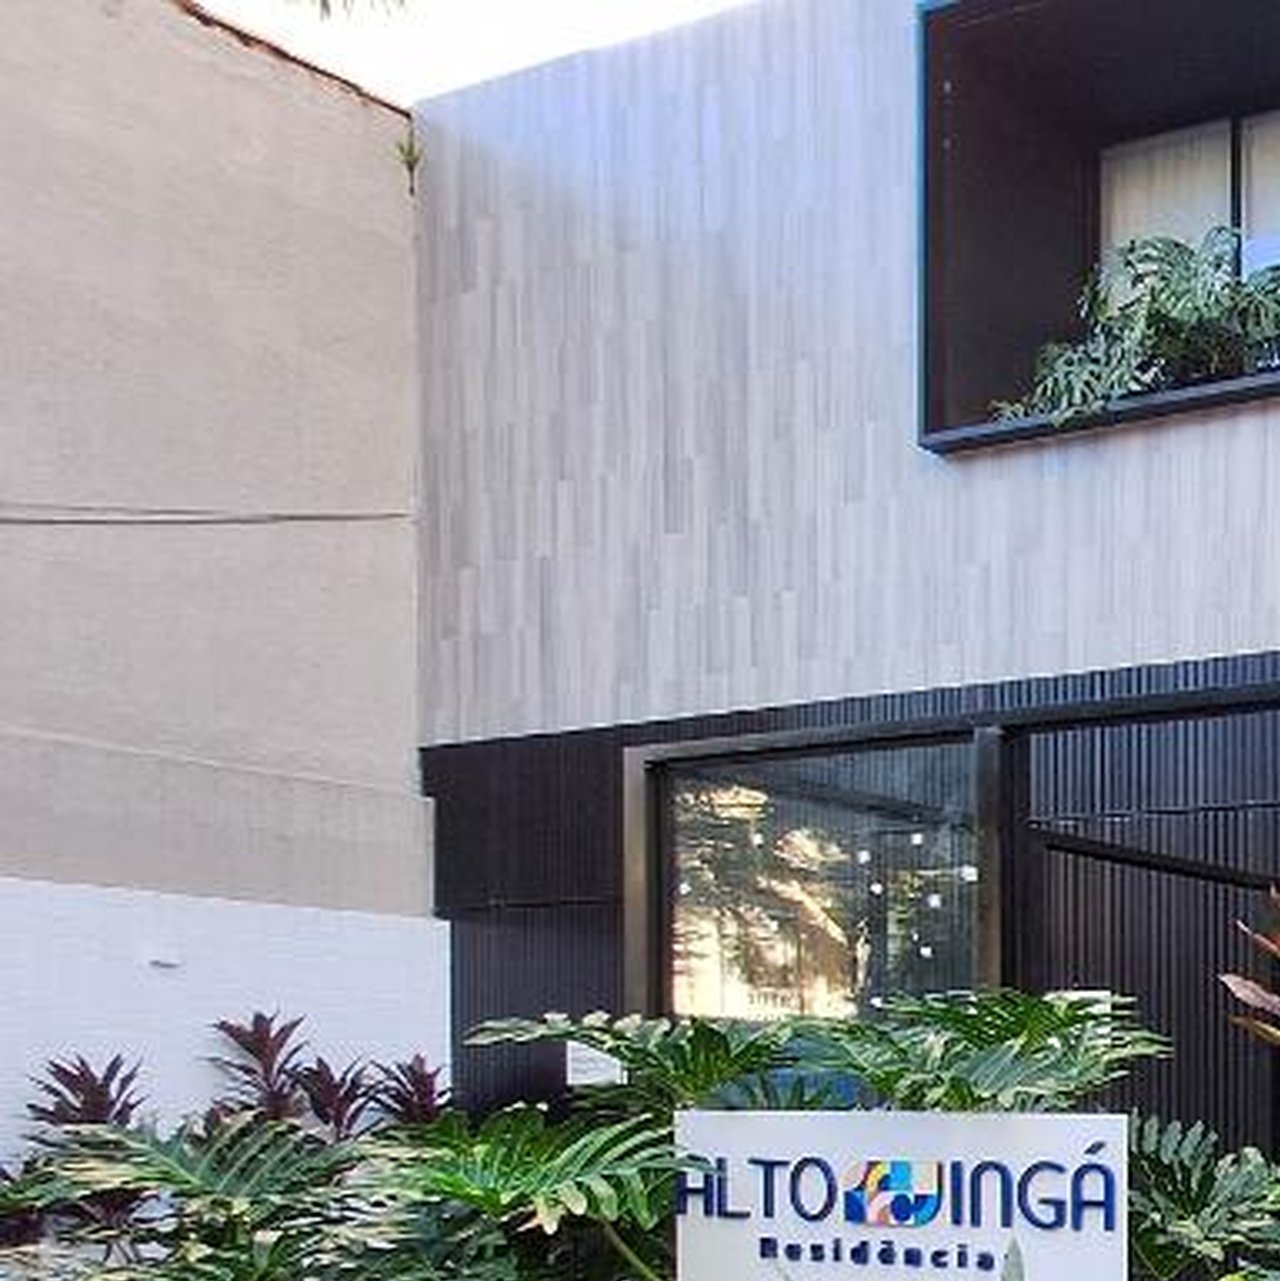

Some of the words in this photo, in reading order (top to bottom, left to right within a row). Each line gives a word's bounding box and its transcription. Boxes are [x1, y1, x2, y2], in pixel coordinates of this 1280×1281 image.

[676, 1155, 838, 1221] ALTO
[951, 1141, 1116, 1232] INGÁ
[759, 1237, 1009, 1273] Residência
